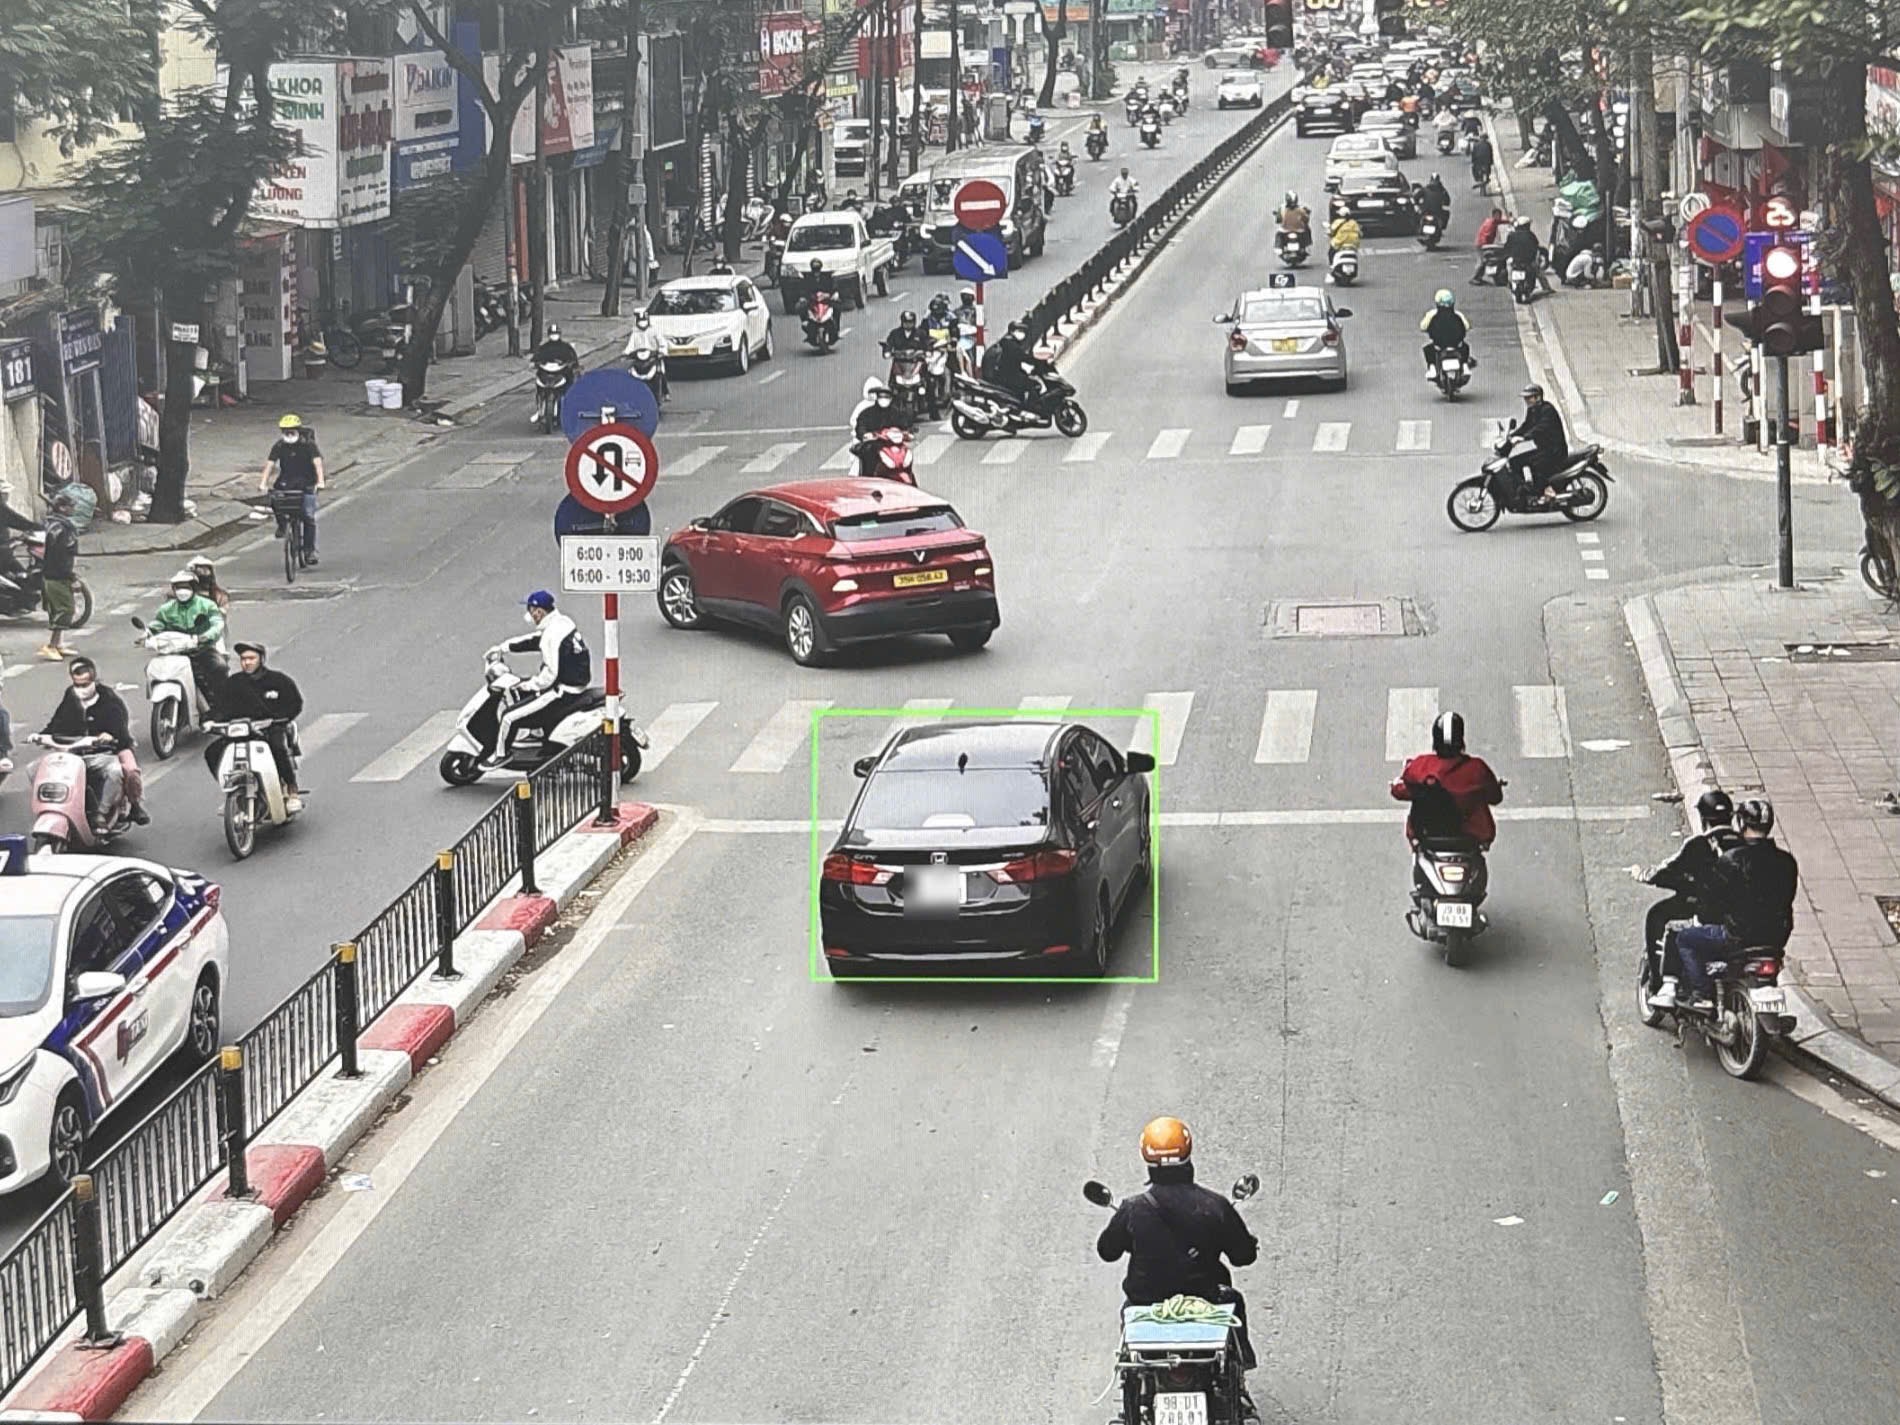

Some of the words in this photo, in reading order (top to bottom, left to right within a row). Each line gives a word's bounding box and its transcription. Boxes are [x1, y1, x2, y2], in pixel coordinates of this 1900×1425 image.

[6, 356, 31, 387] 181
[577, 547, 603, 561] 6:00
[618, 547, 643, 561] 9:00
[570, 568, 603, 583] 16:00
[618, 568, 651, 583] 19:30
